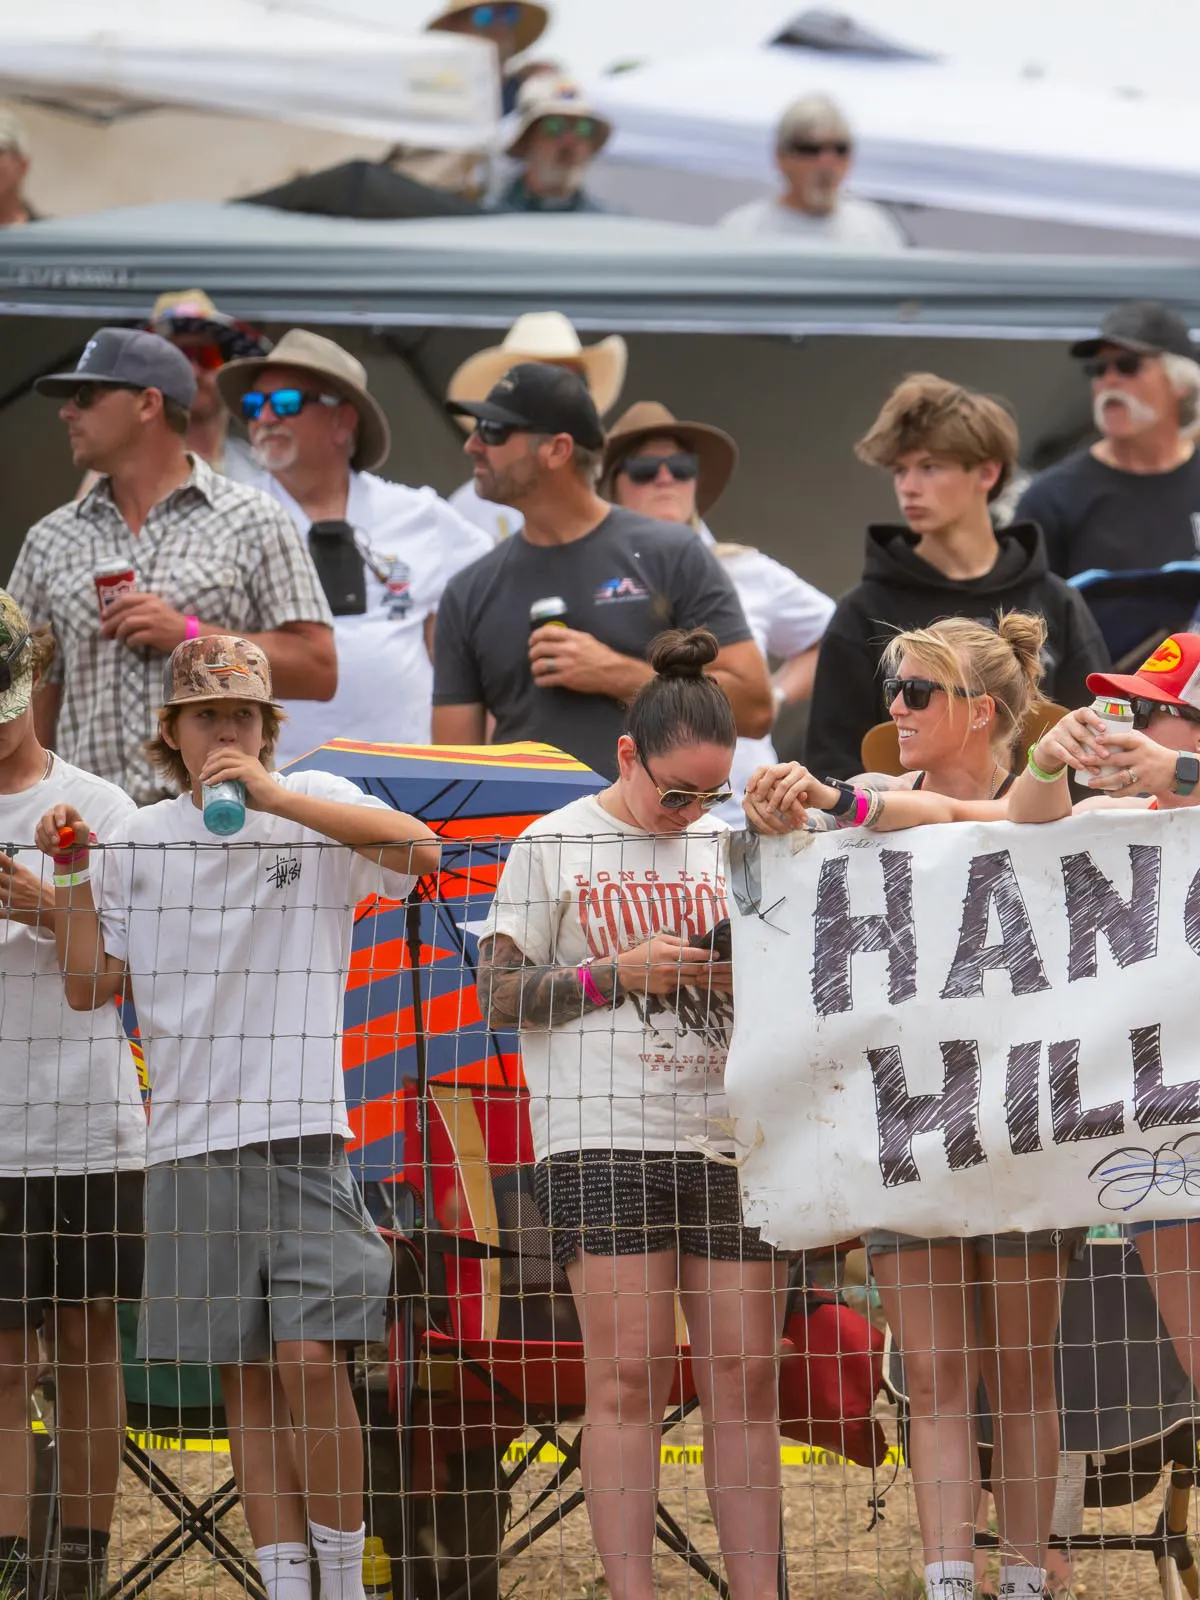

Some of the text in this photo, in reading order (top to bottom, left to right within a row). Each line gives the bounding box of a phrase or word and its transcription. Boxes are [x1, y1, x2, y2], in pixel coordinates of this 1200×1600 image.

[574, 870, 661, 887] LONG
[578, 882, 729, 959] COWBO
[638, 1053, 728, 1065] WRANGLE
